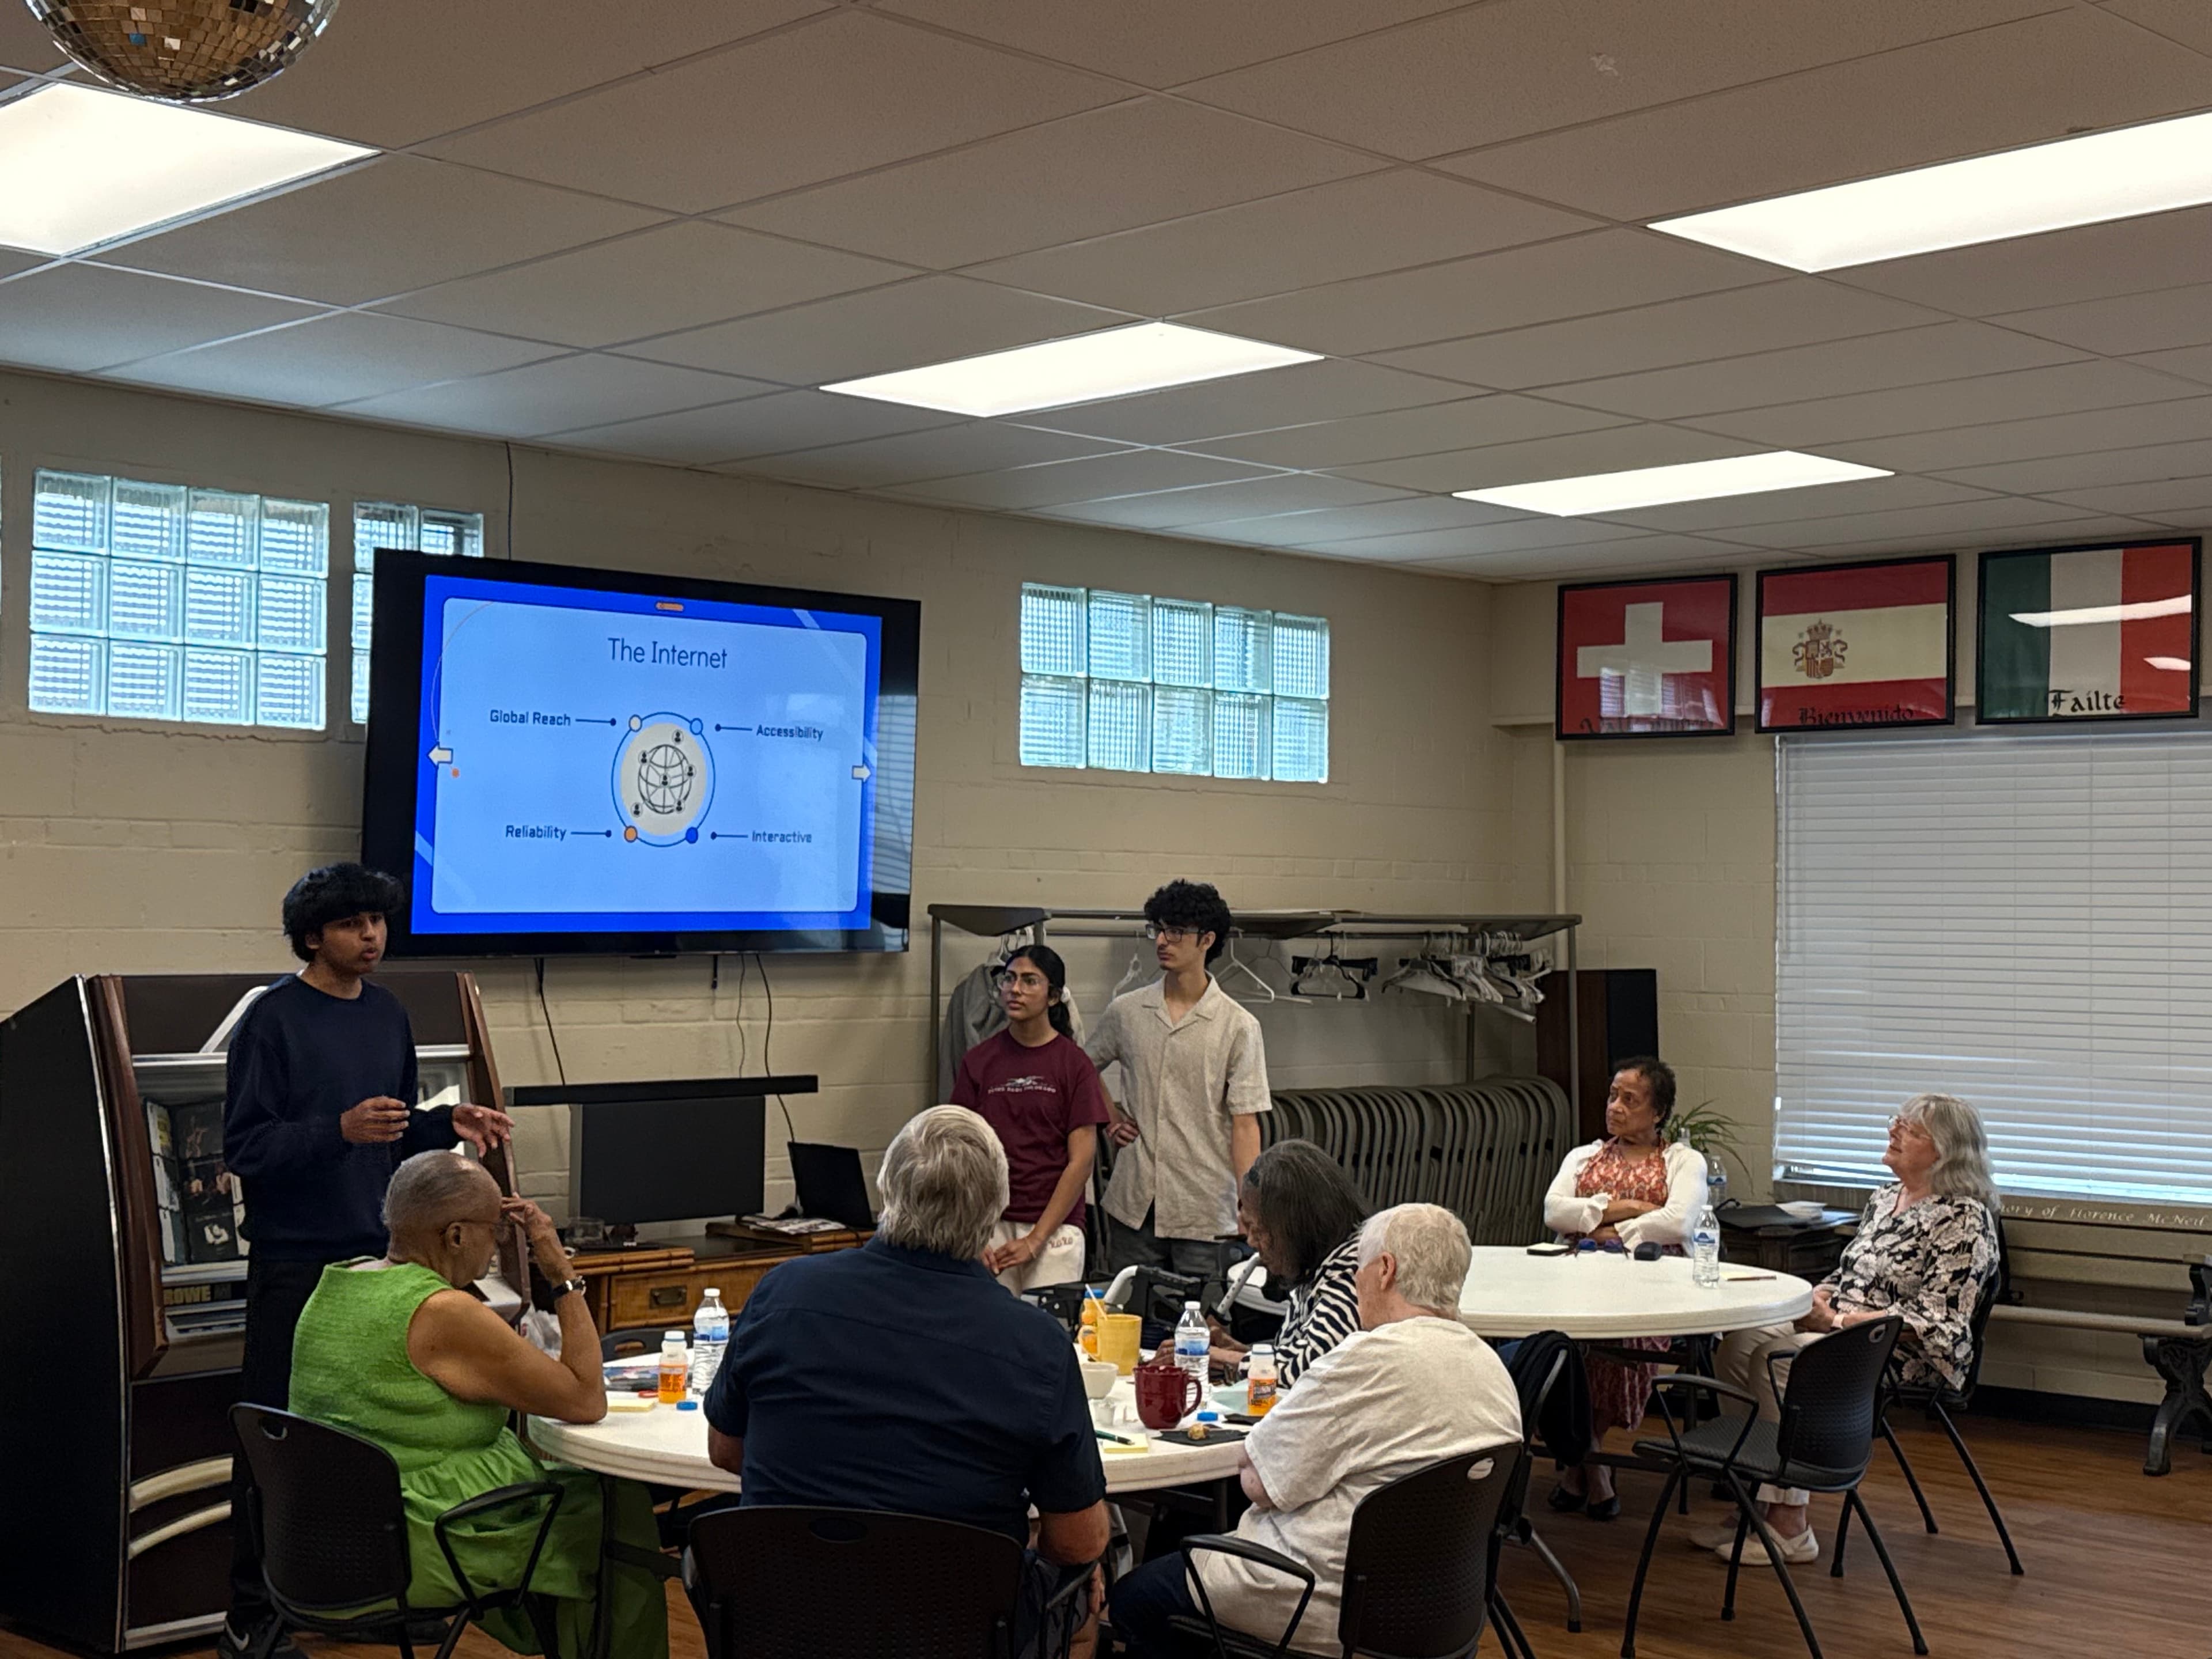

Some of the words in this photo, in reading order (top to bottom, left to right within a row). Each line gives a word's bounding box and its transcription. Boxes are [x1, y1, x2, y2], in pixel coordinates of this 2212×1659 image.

[608, 637, 645, 663] The
[652, 641, 728, 669] Internet
[2048, 688, 2127, 713] Failte
[490, 709, 529, 724] Global
[532, 711, 571, 726] Reach
[1797, 703, 1914, 725] Bienvenido
[756, 724, 824, 742] Accessibility
[506, 825, 567, 841] Reliability
[752, 830, 812, 843] Interactive
[2041, 1205, 2060, 1218] of
[2070, 1207, 2134, 1222] Florence
[163, 1285, 211, 1305] ROWE
